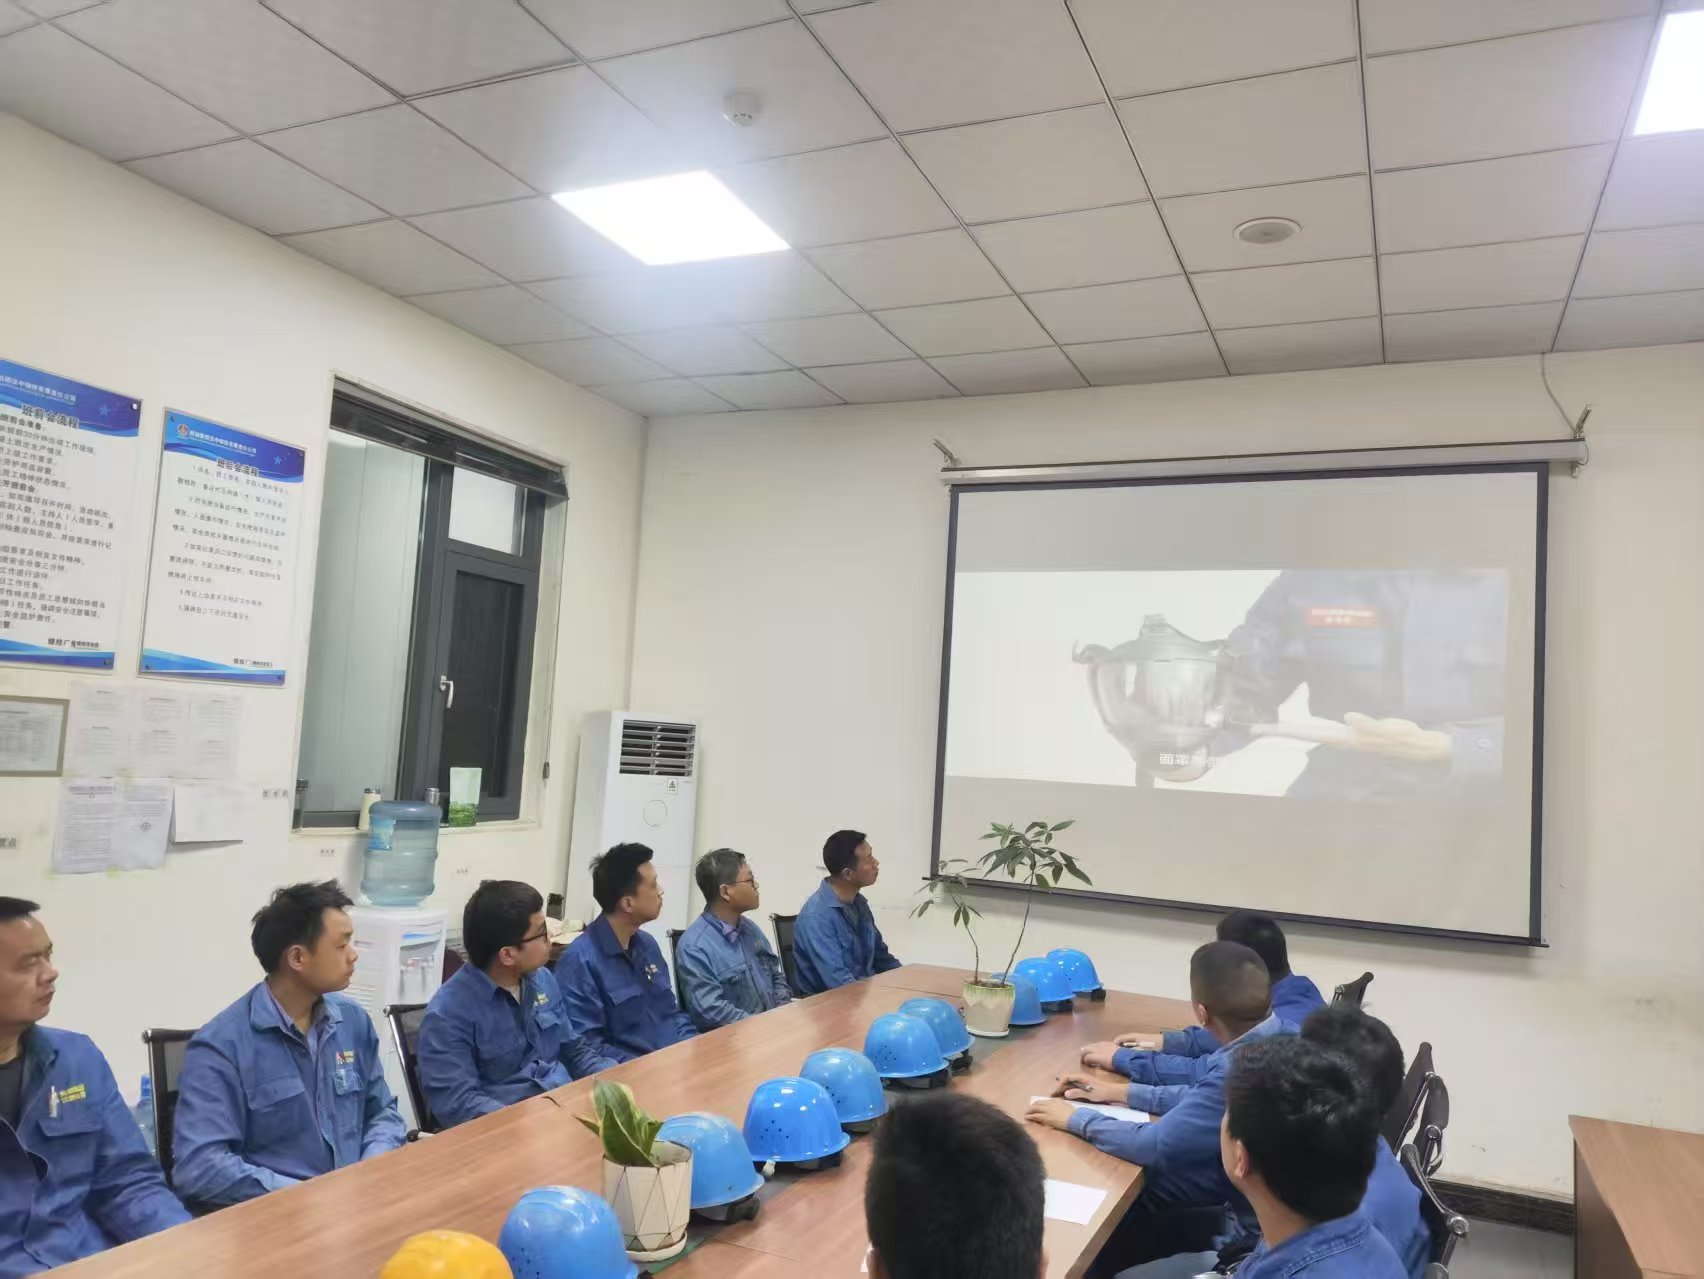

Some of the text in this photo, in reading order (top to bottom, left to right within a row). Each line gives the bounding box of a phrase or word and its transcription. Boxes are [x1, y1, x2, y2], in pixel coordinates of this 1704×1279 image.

[22, 404, 80, 429] 班前会流程
[217, 458, 259, 477] 班后会流程
